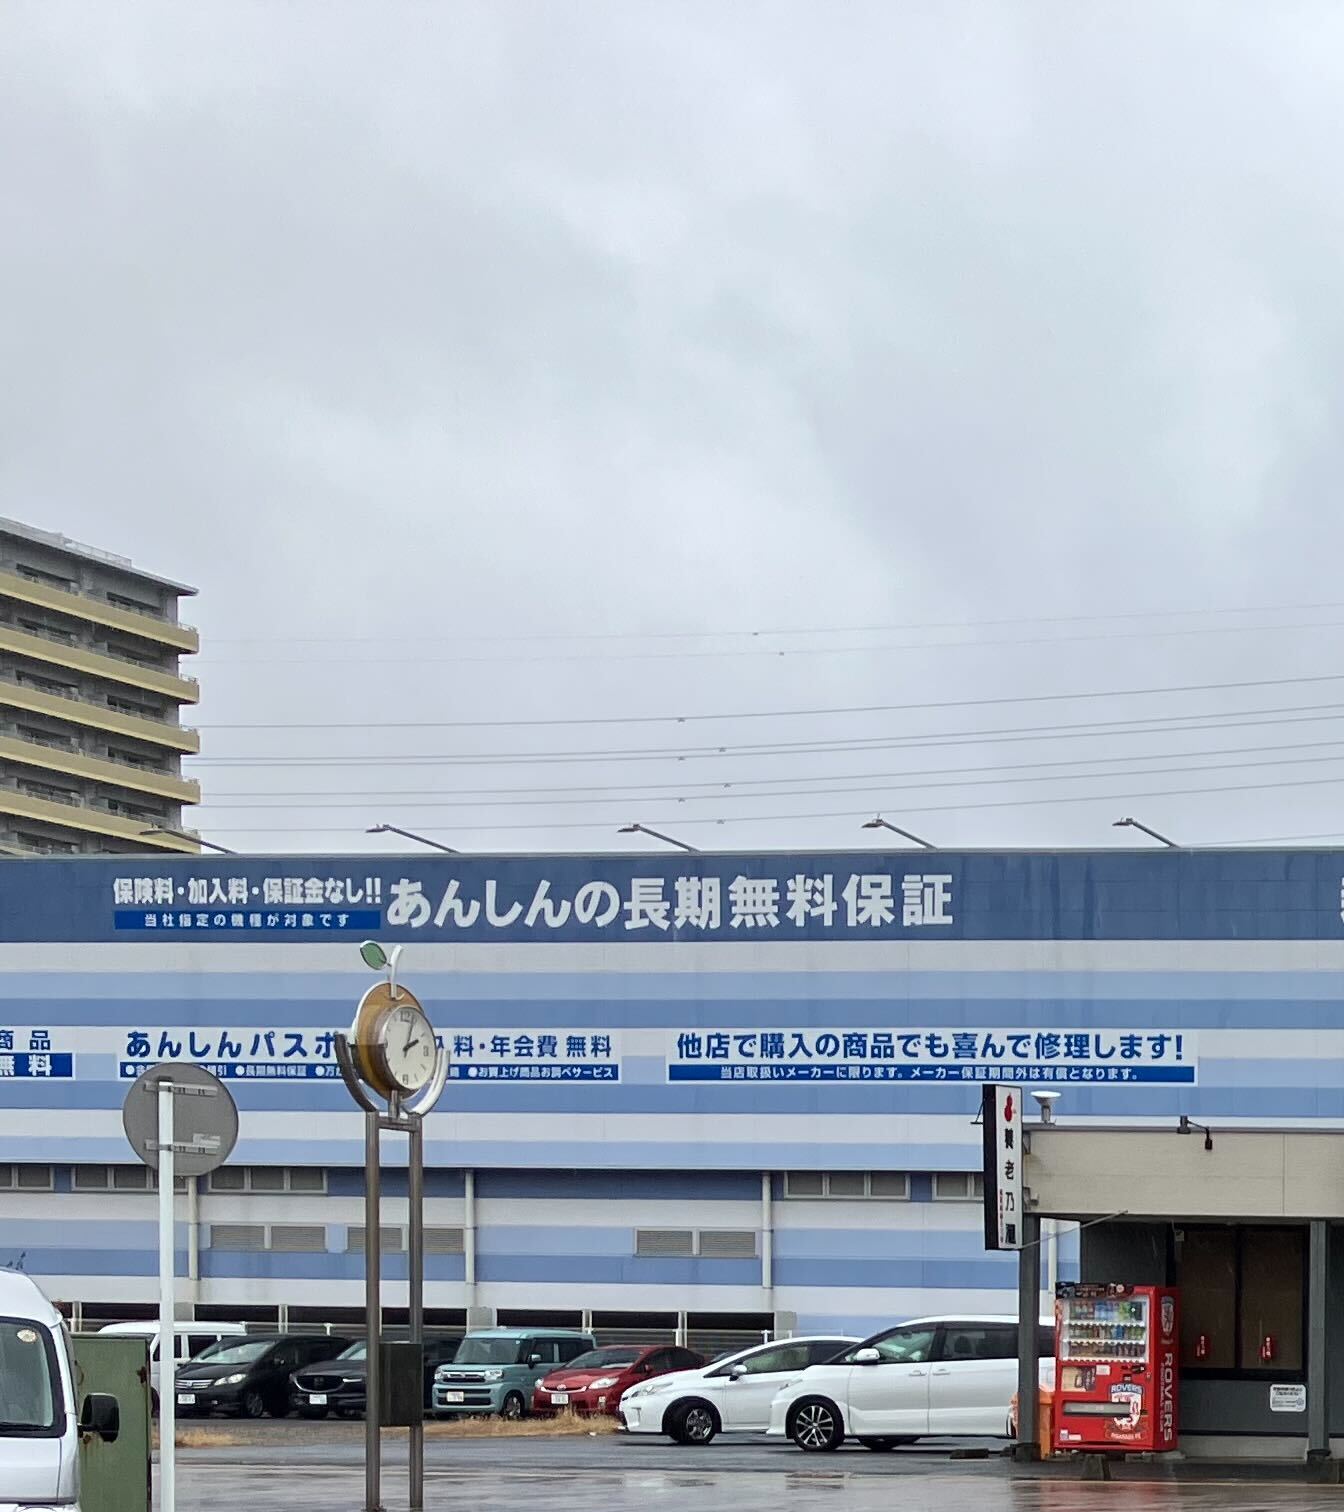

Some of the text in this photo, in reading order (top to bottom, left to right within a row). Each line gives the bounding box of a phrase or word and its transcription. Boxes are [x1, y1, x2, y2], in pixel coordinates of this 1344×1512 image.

[144, 913, 350, 928] 当社指定の機種が対象です
[386, 873, 954, 930] あんしんの長期無料保証
[1164, 1352, 1174, 1441] ROVERS
